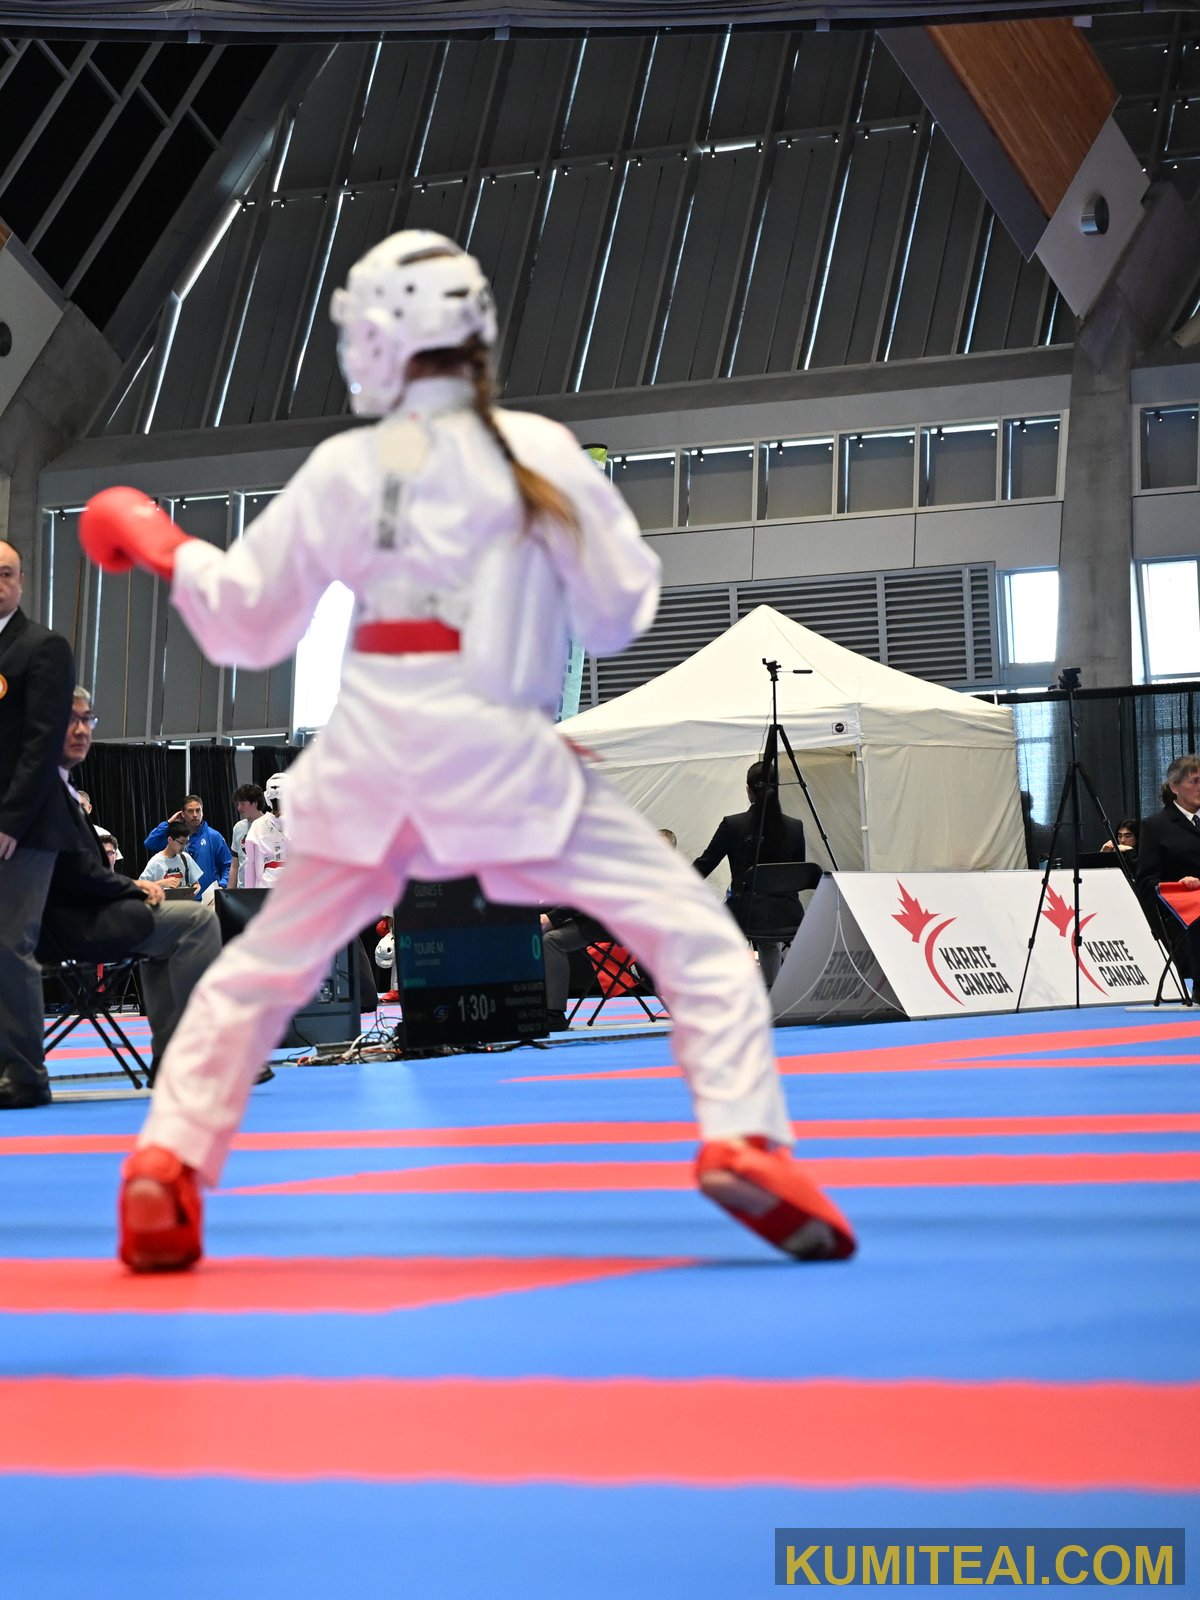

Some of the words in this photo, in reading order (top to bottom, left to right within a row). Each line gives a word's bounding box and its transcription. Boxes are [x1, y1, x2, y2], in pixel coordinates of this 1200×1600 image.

[938, 946, 996, 970] KARATE
[1083, 940, 1134, 962] KARATE
[955, 972, 1013, 995] CANADA
[1098, 965, 1149, 987] CANADA
